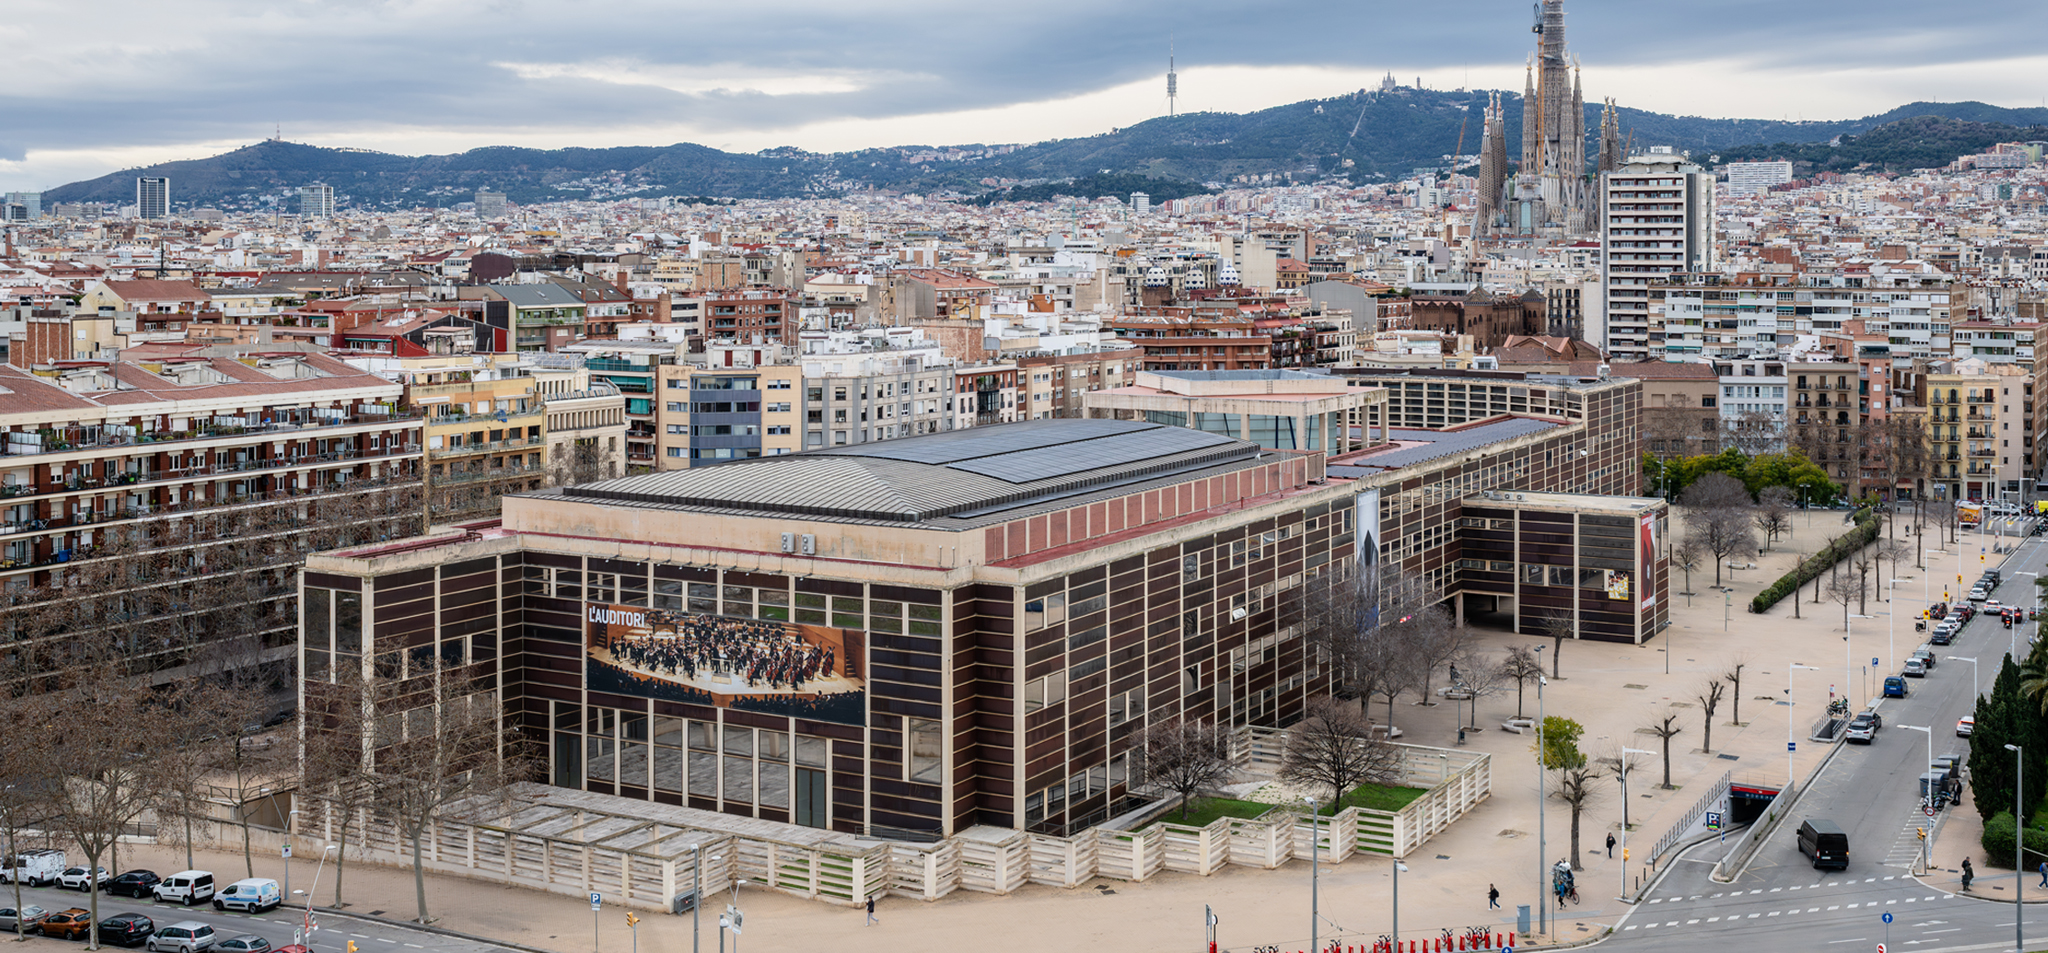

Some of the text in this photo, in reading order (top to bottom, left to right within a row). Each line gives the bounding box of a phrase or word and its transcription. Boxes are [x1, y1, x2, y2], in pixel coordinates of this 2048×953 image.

[589, 605, 645, 627] L'AUDITORI
[1709, 814, 1717, 824] P
[592, 894, 599, 902] P
